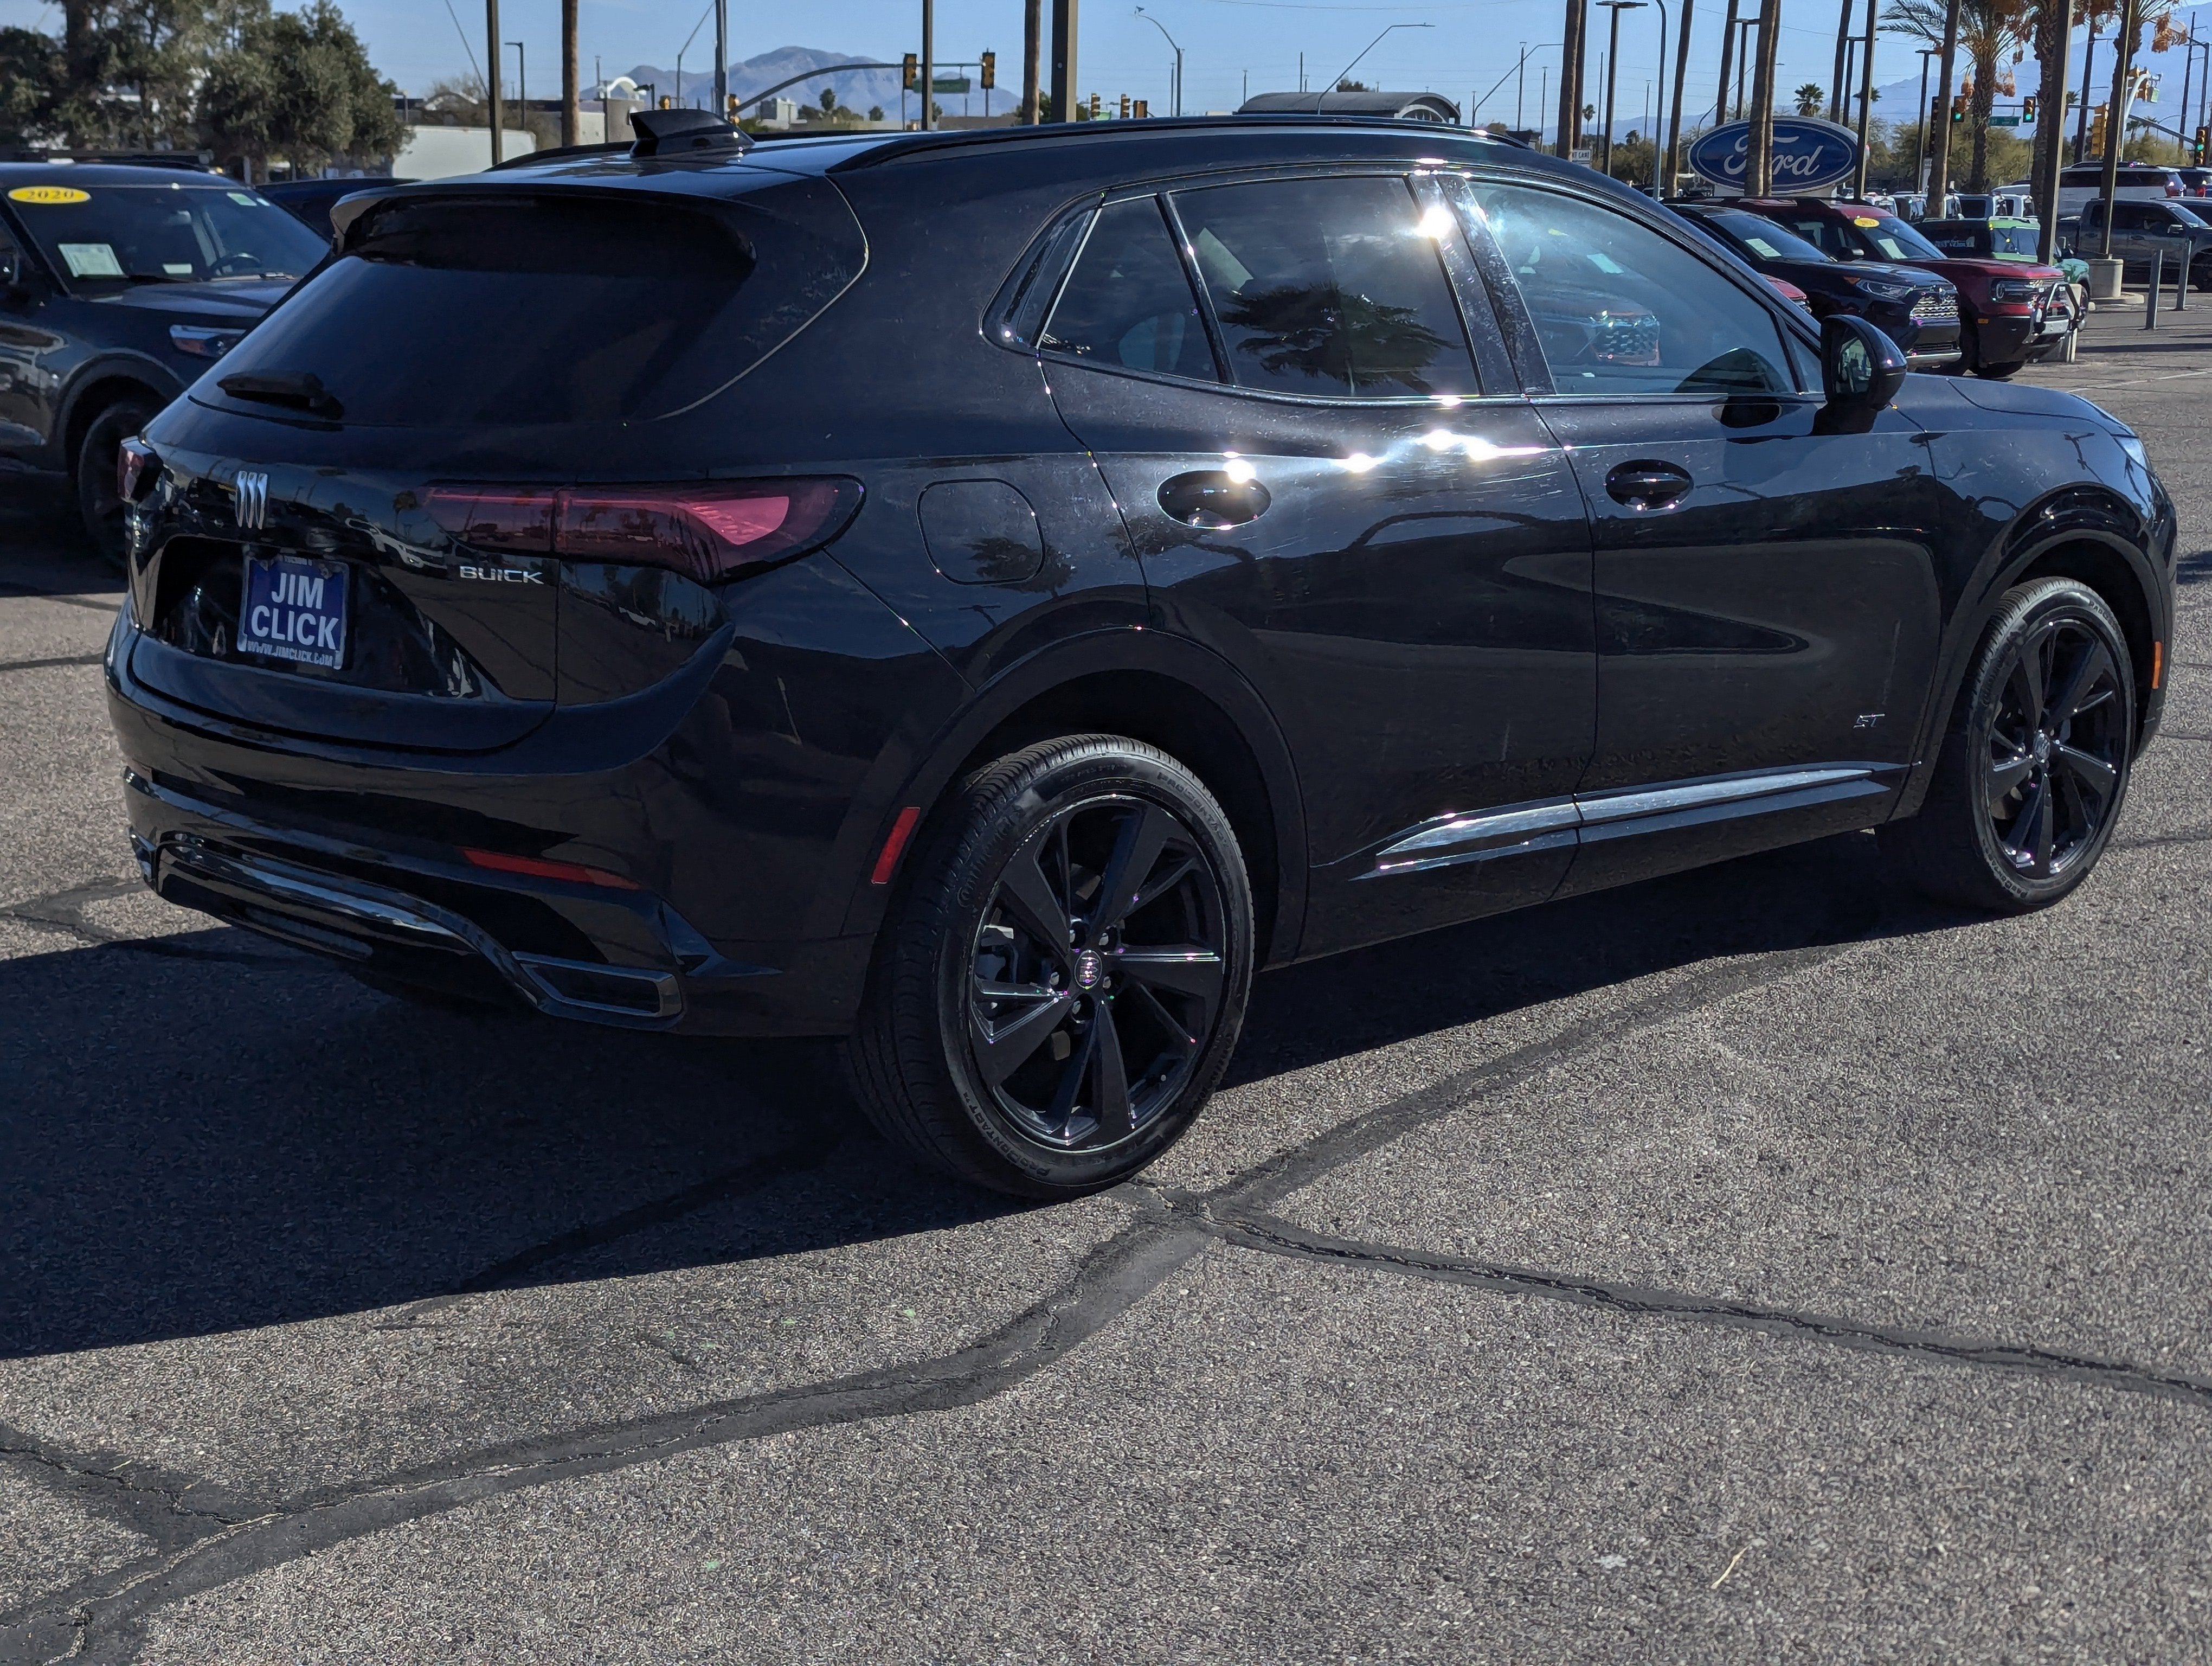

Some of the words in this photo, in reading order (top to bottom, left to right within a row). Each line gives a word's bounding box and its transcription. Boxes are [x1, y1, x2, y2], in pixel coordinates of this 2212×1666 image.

[1724, 134, 1823, 176] Frd
[28, 190, 74, 200] 2020
[460, 566, 544, 584] BUICK
[272, 572, 324, 610] JIM
[251, 605, 339, 650] CLICK
[1853, 713, 1885, 729] ST
